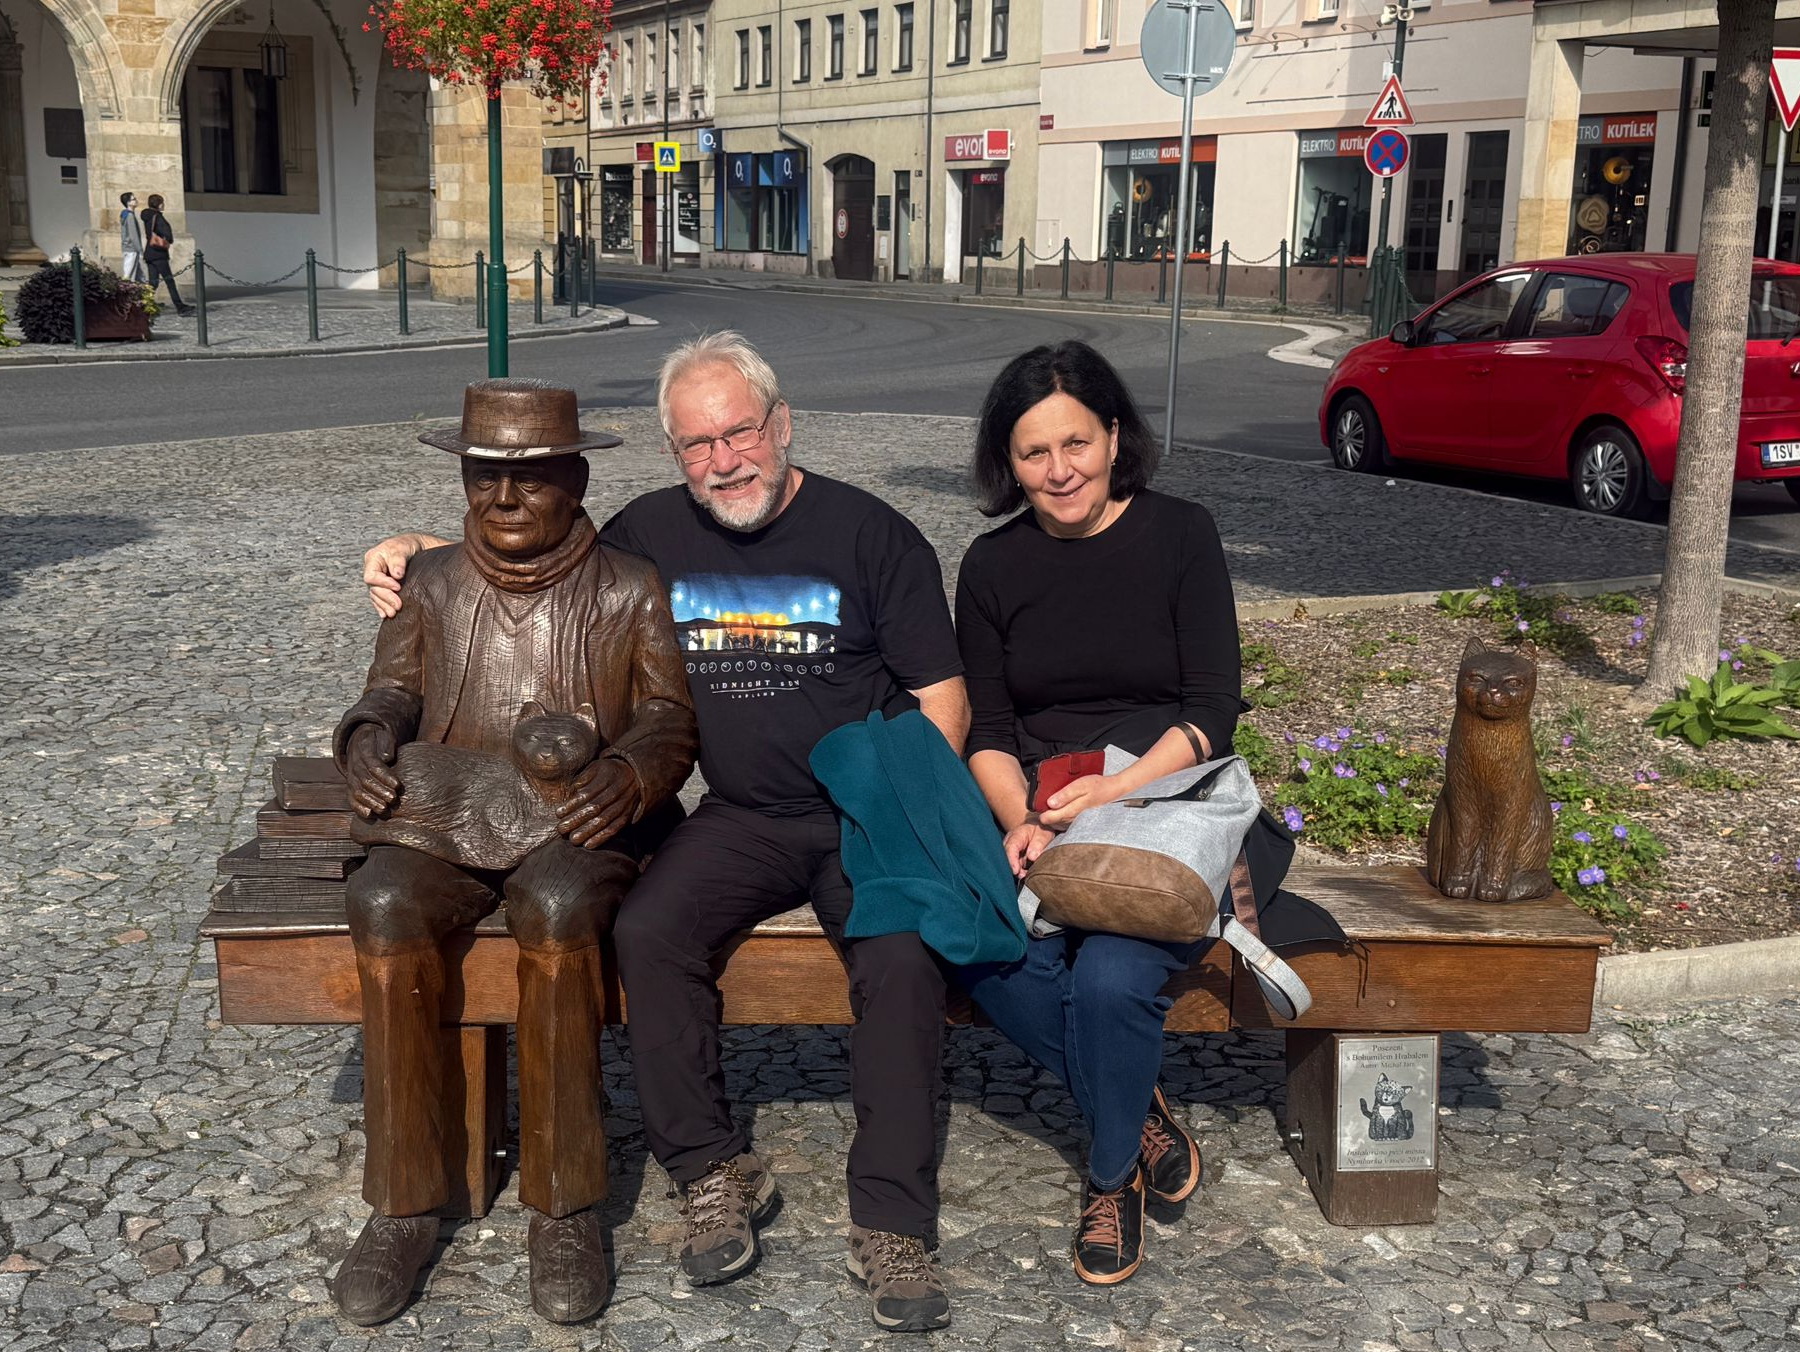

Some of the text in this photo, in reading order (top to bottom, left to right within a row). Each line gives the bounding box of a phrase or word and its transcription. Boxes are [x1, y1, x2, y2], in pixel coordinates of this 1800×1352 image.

[1607, 120, 1654, 138] KUTÍLEK
[1131, 144, 1182, 160] ELEKTRO KUTÍL
[1301, 139, 1335, 153] ELEKTRO
[1773, 444, 1793, 459] 1SV
[710, 679, 770, 690] MIDNIGHT
